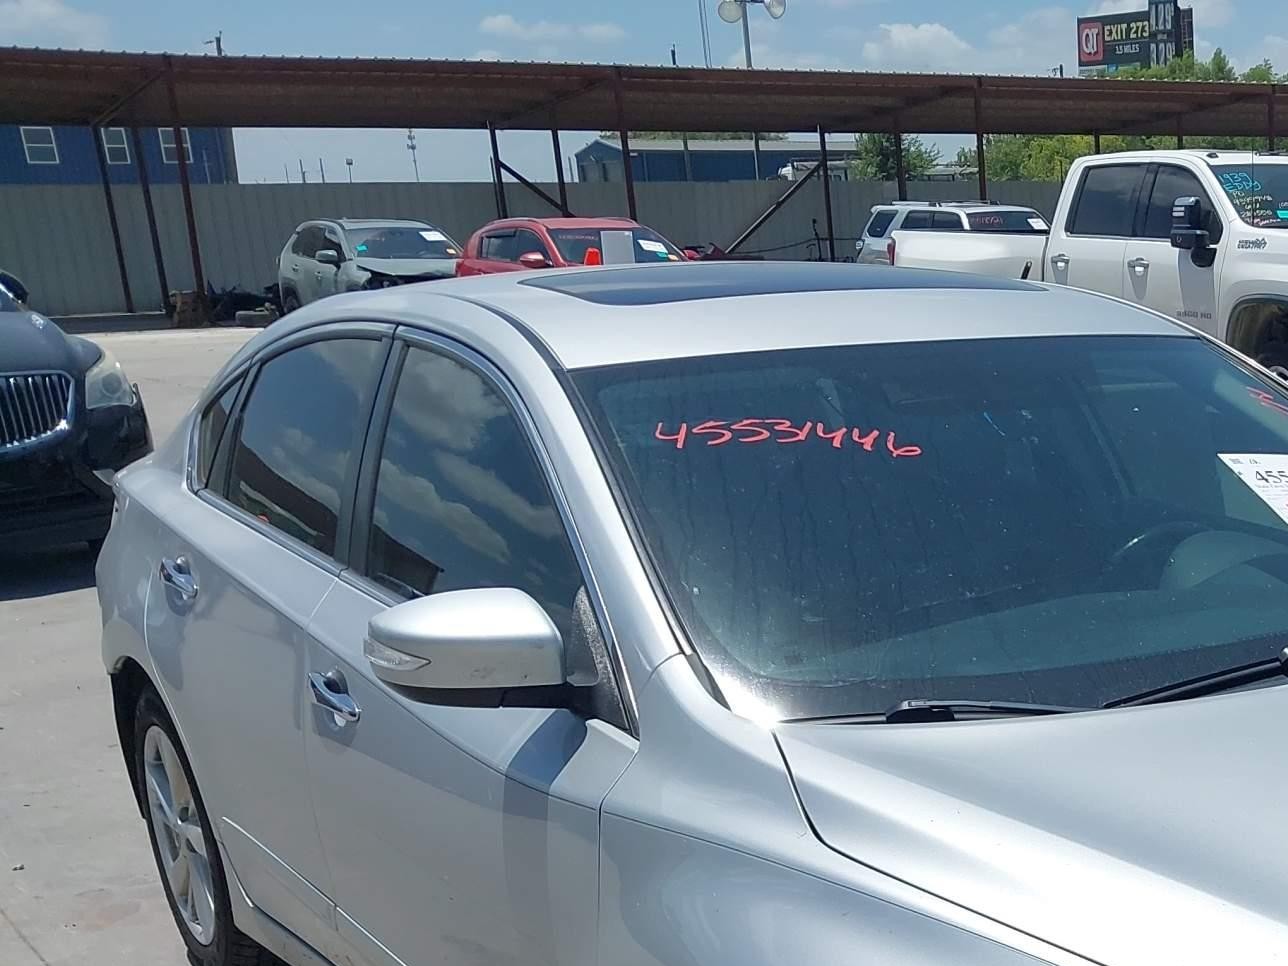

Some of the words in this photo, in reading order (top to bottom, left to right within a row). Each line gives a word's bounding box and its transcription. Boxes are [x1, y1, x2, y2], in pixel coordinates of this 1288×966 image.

[1082, 28, 1098, 55] QT
[1104, 24, 1127, 41] EXIT
[1130, 21, 1149, 39] 273
[1124, 43, 1139, 53] MILES
[655, 419, 922, 457] 45531446
